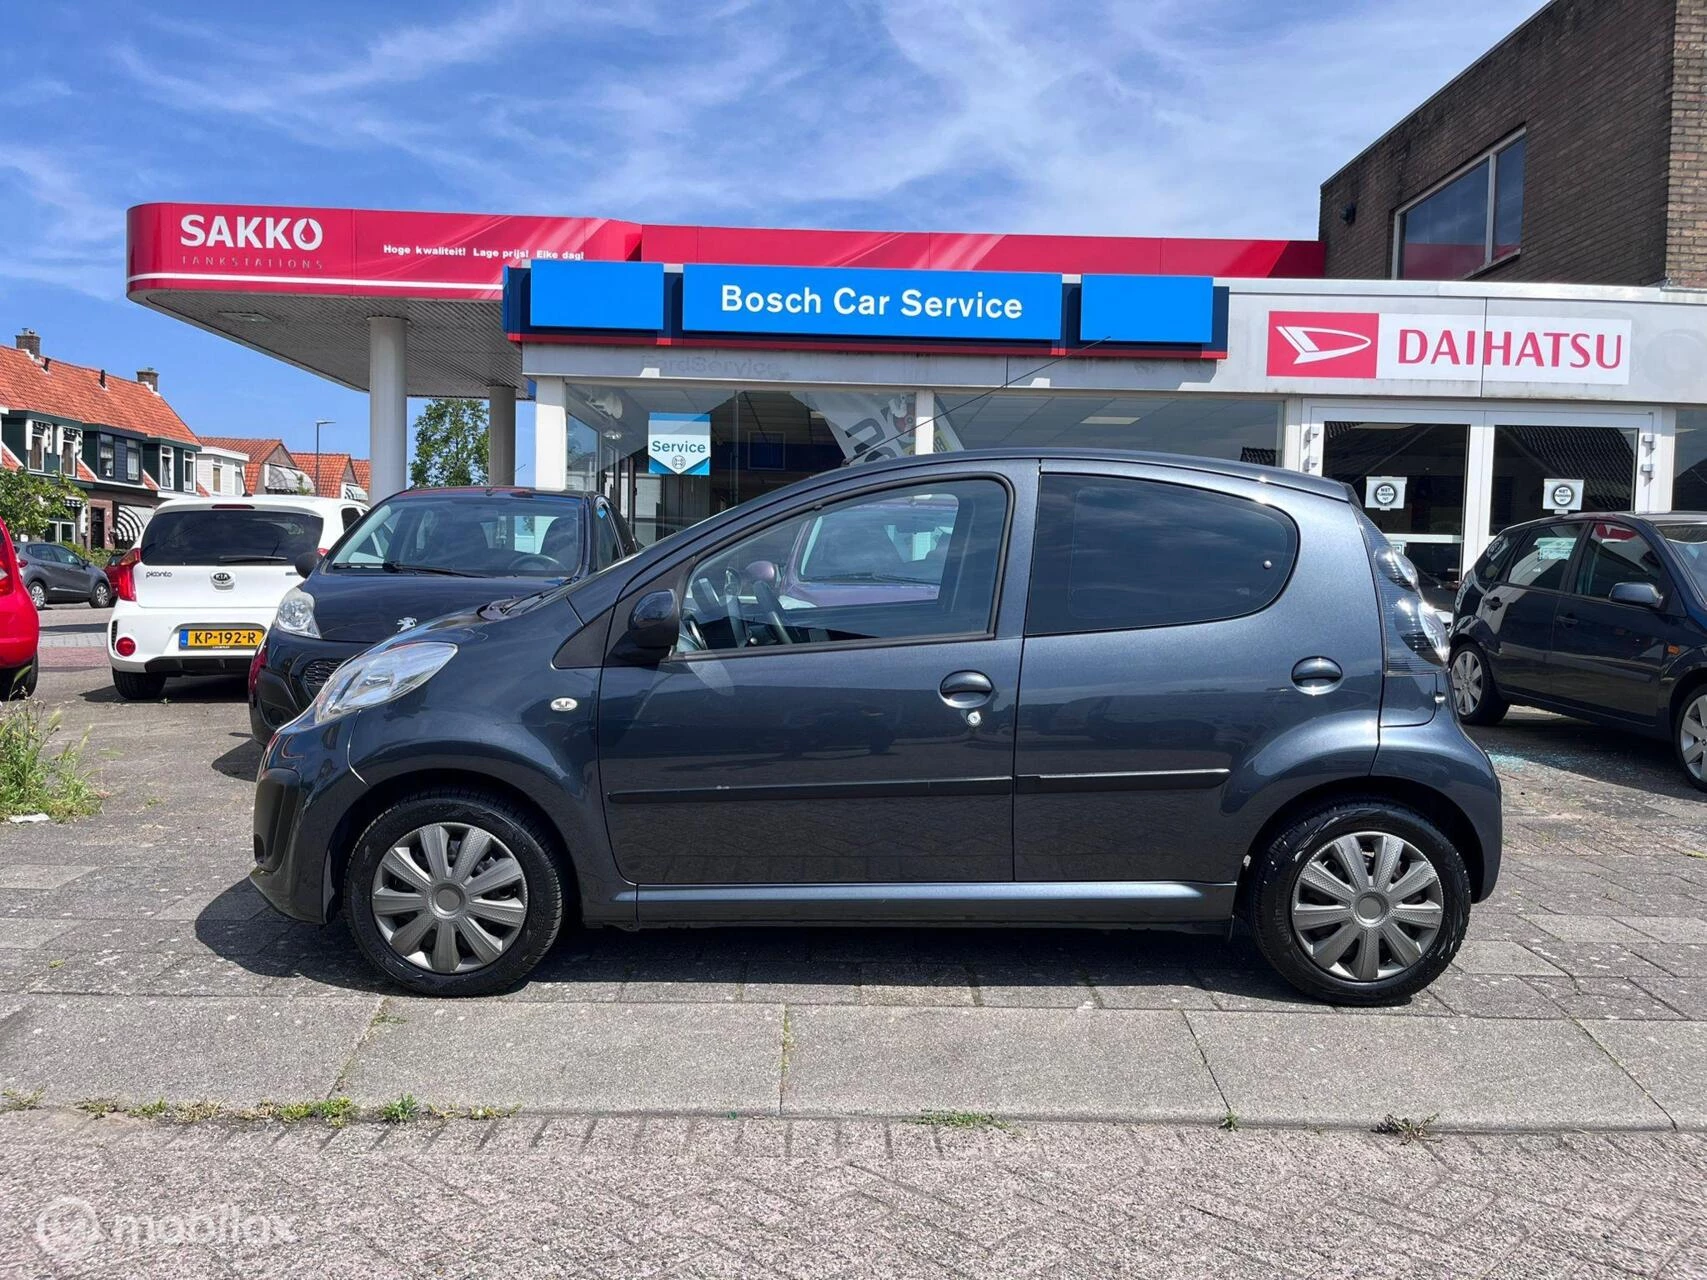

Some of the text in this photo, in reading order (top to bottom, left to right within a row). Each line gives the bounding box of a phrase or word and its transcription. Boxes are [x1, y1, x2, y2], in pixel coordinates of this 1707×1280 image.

[180, 214, 323, 250] SAKKO
[383, 245, 411, 254] Hoge
[415, 246, 466, 256] kwaliteit!
[473, 248, 499, 257] Lage
[502, 249, 529, 259] prijs!
[562, 251, 584, 260] dag!
[181, 256, 323, 269] TANKSTATIONS
[721, 284, 1023, 319] Bosch Car Service
[1398, 329, 1622, 369] DAIHATSU
[652, 440, 706, 453] Service
[215, 573, 230, 581] KIA
[194, 632, 256, 644] KP-192-R
